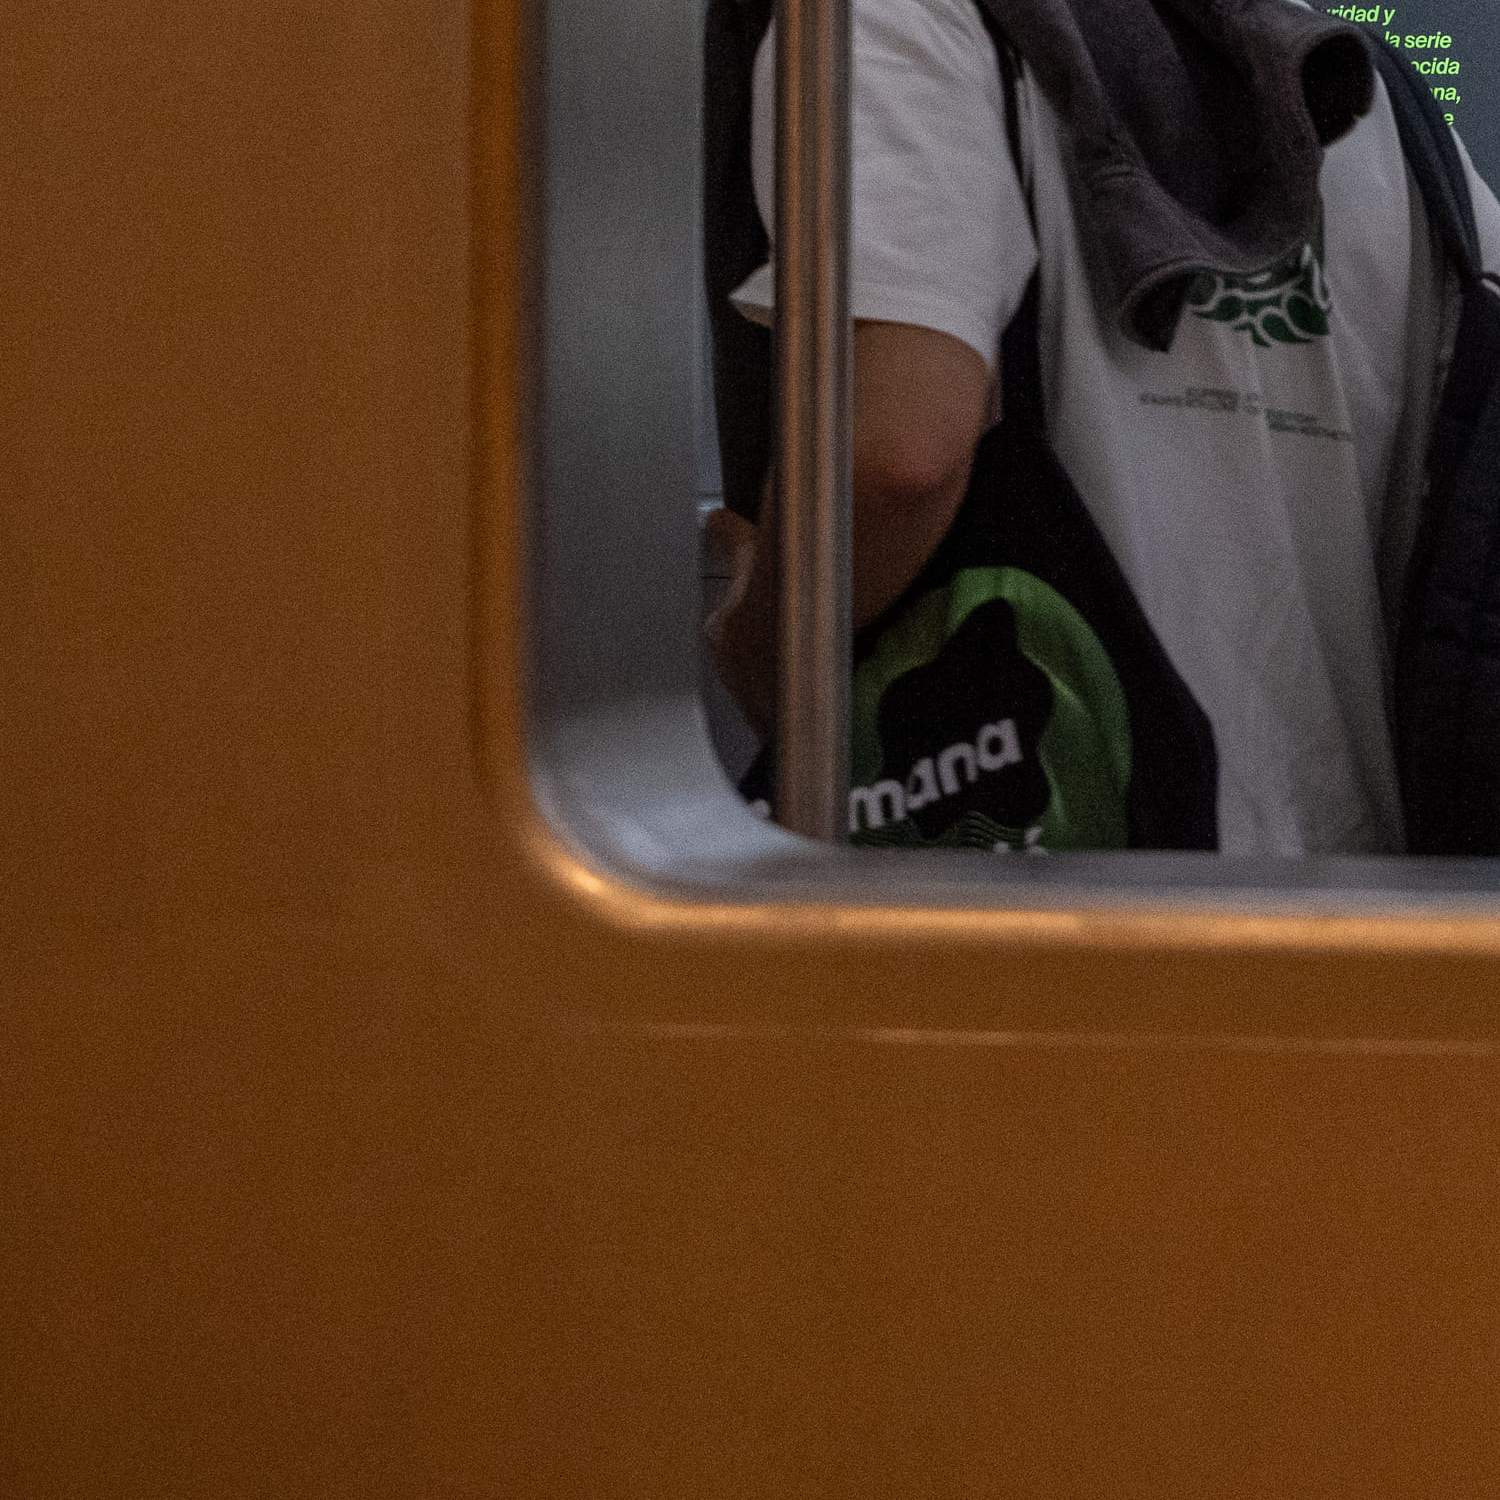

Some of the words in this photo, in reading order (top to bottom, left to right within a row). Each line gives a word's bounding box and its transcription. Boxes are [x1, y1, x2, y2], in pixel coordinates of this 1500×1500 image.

[1382, 8, 1397, 27] y
[1403, 30, 1453, 50] serie
[849, 717, 1024, 834] mana
